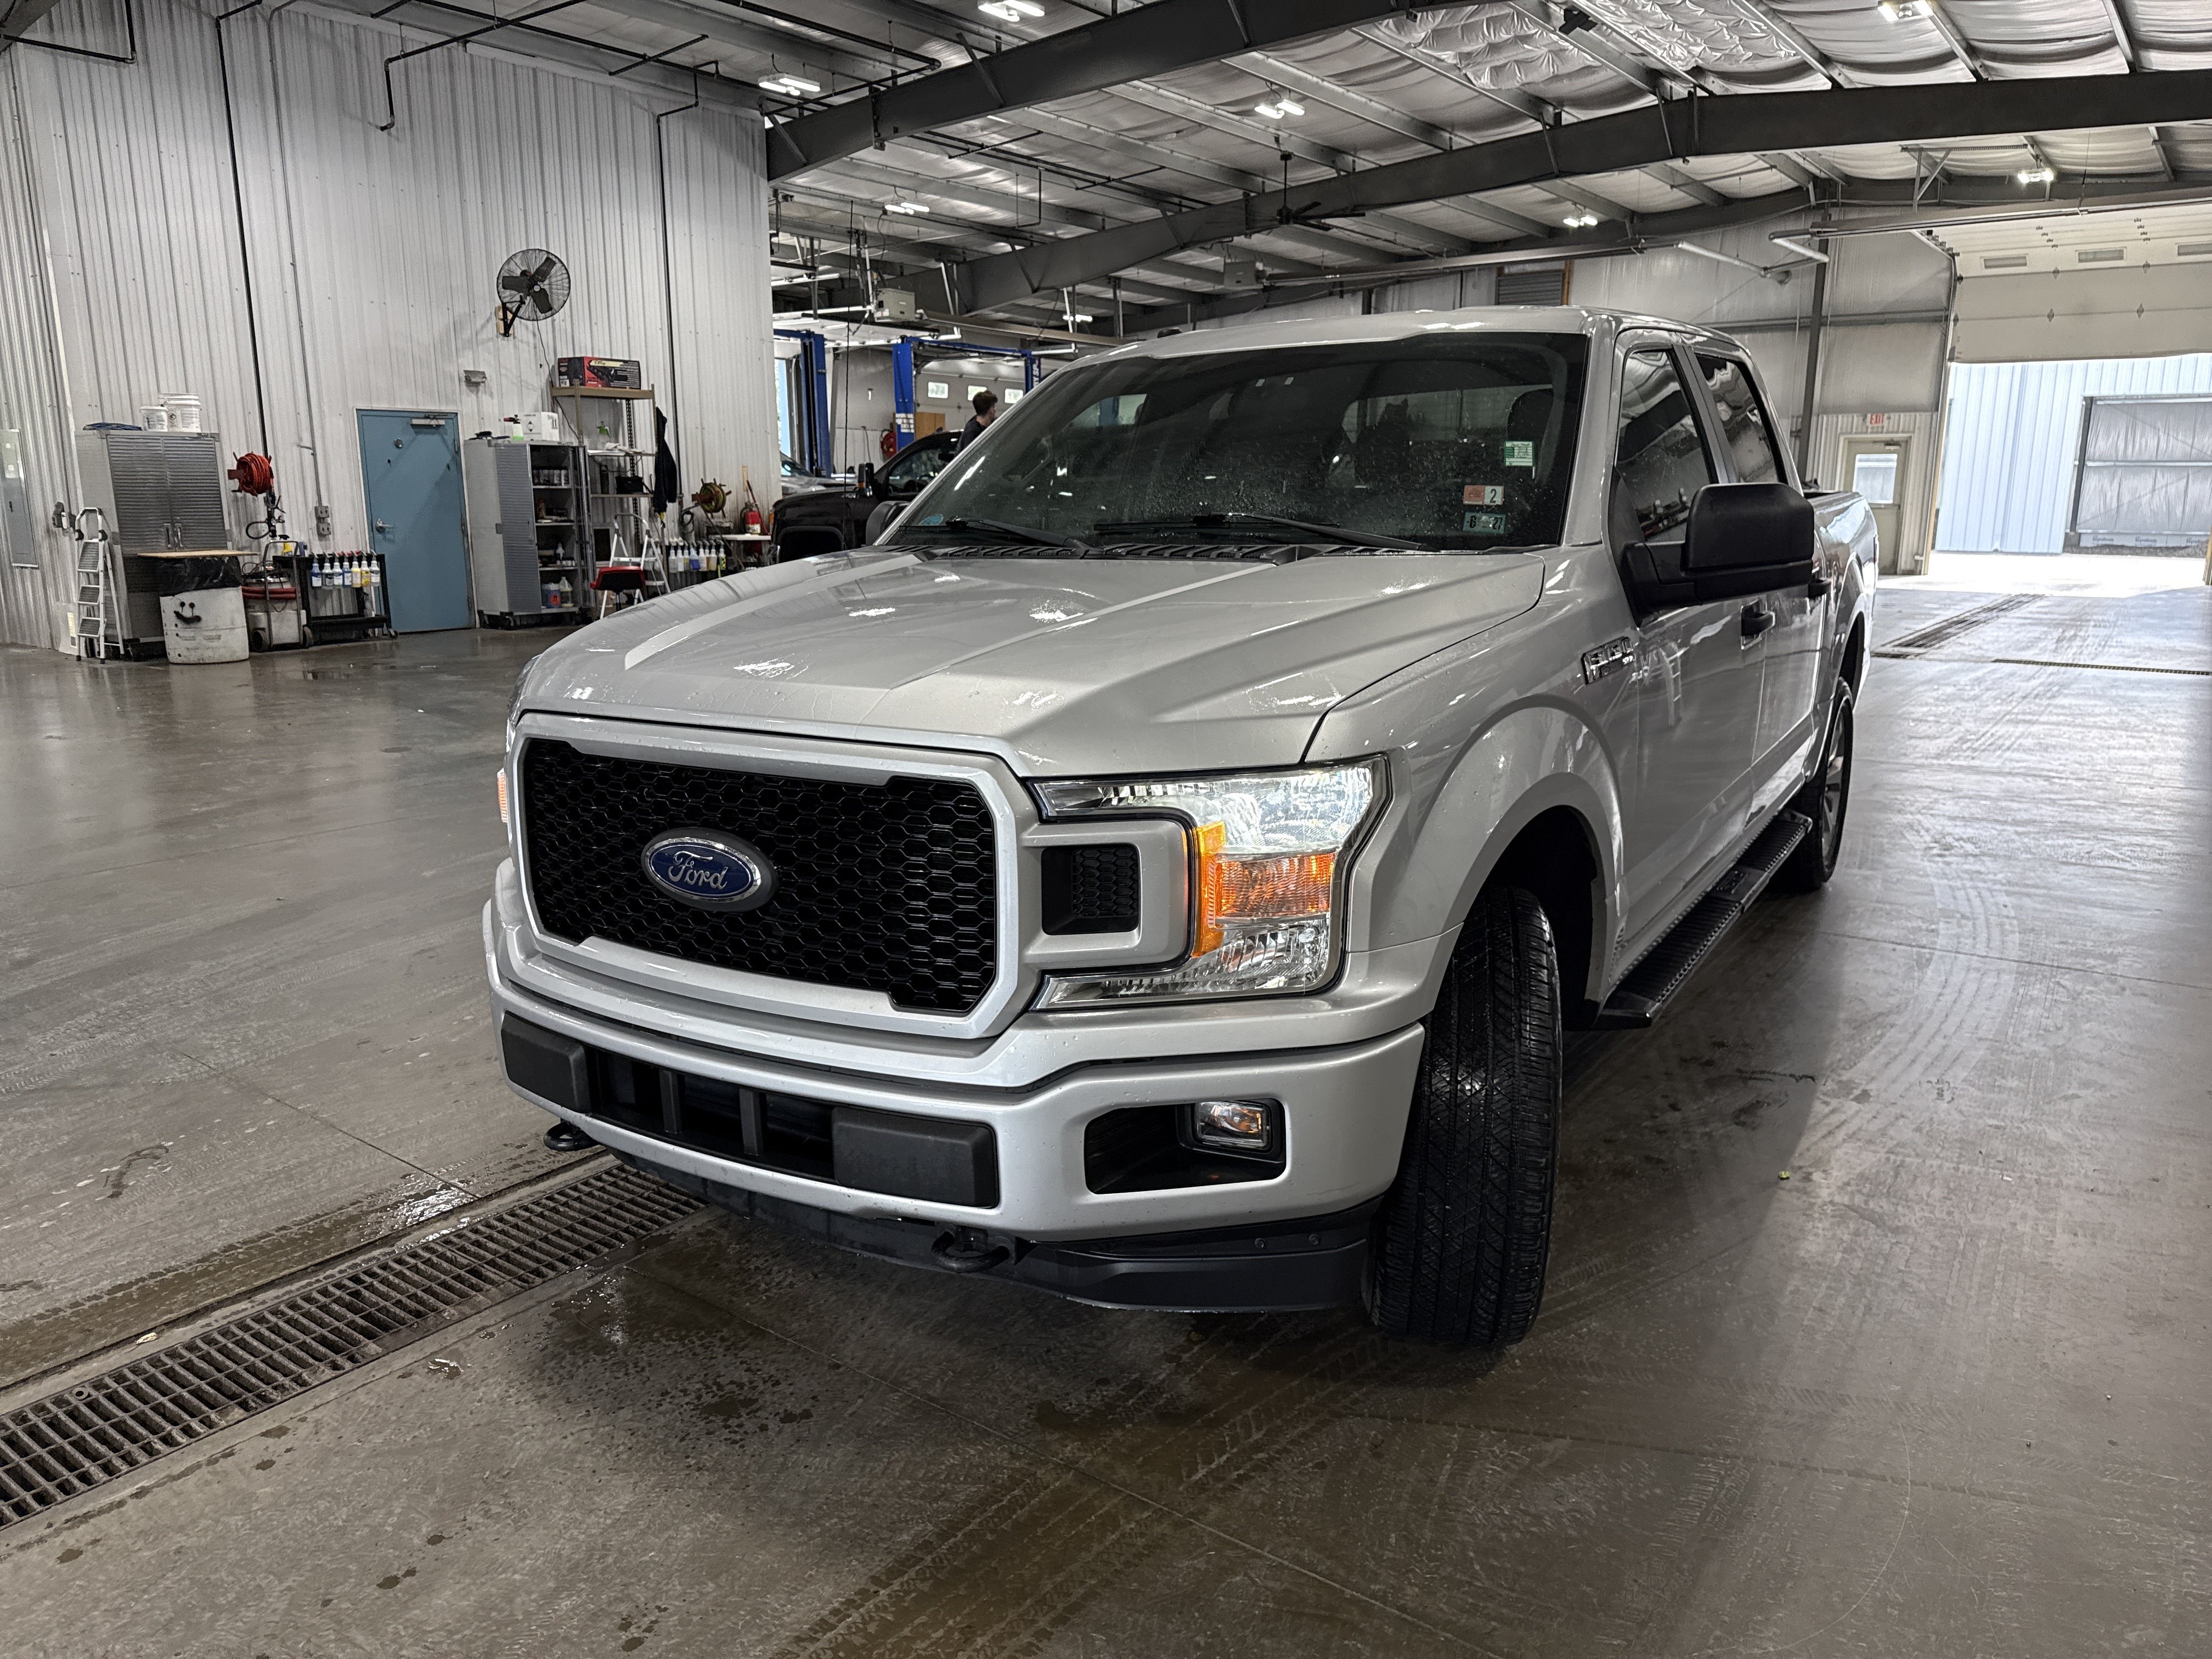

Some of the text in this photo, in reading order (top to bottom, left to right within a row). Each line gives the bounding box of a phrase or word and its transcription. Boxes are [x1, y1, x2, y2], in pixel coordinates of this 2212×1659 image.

[1870, 413, 1884, 425] EXIT
[1489, 488, 1497, 503] 2
[1469, 515, 1503, 531] 6 27
[668, 851, 729, 890] Ford
